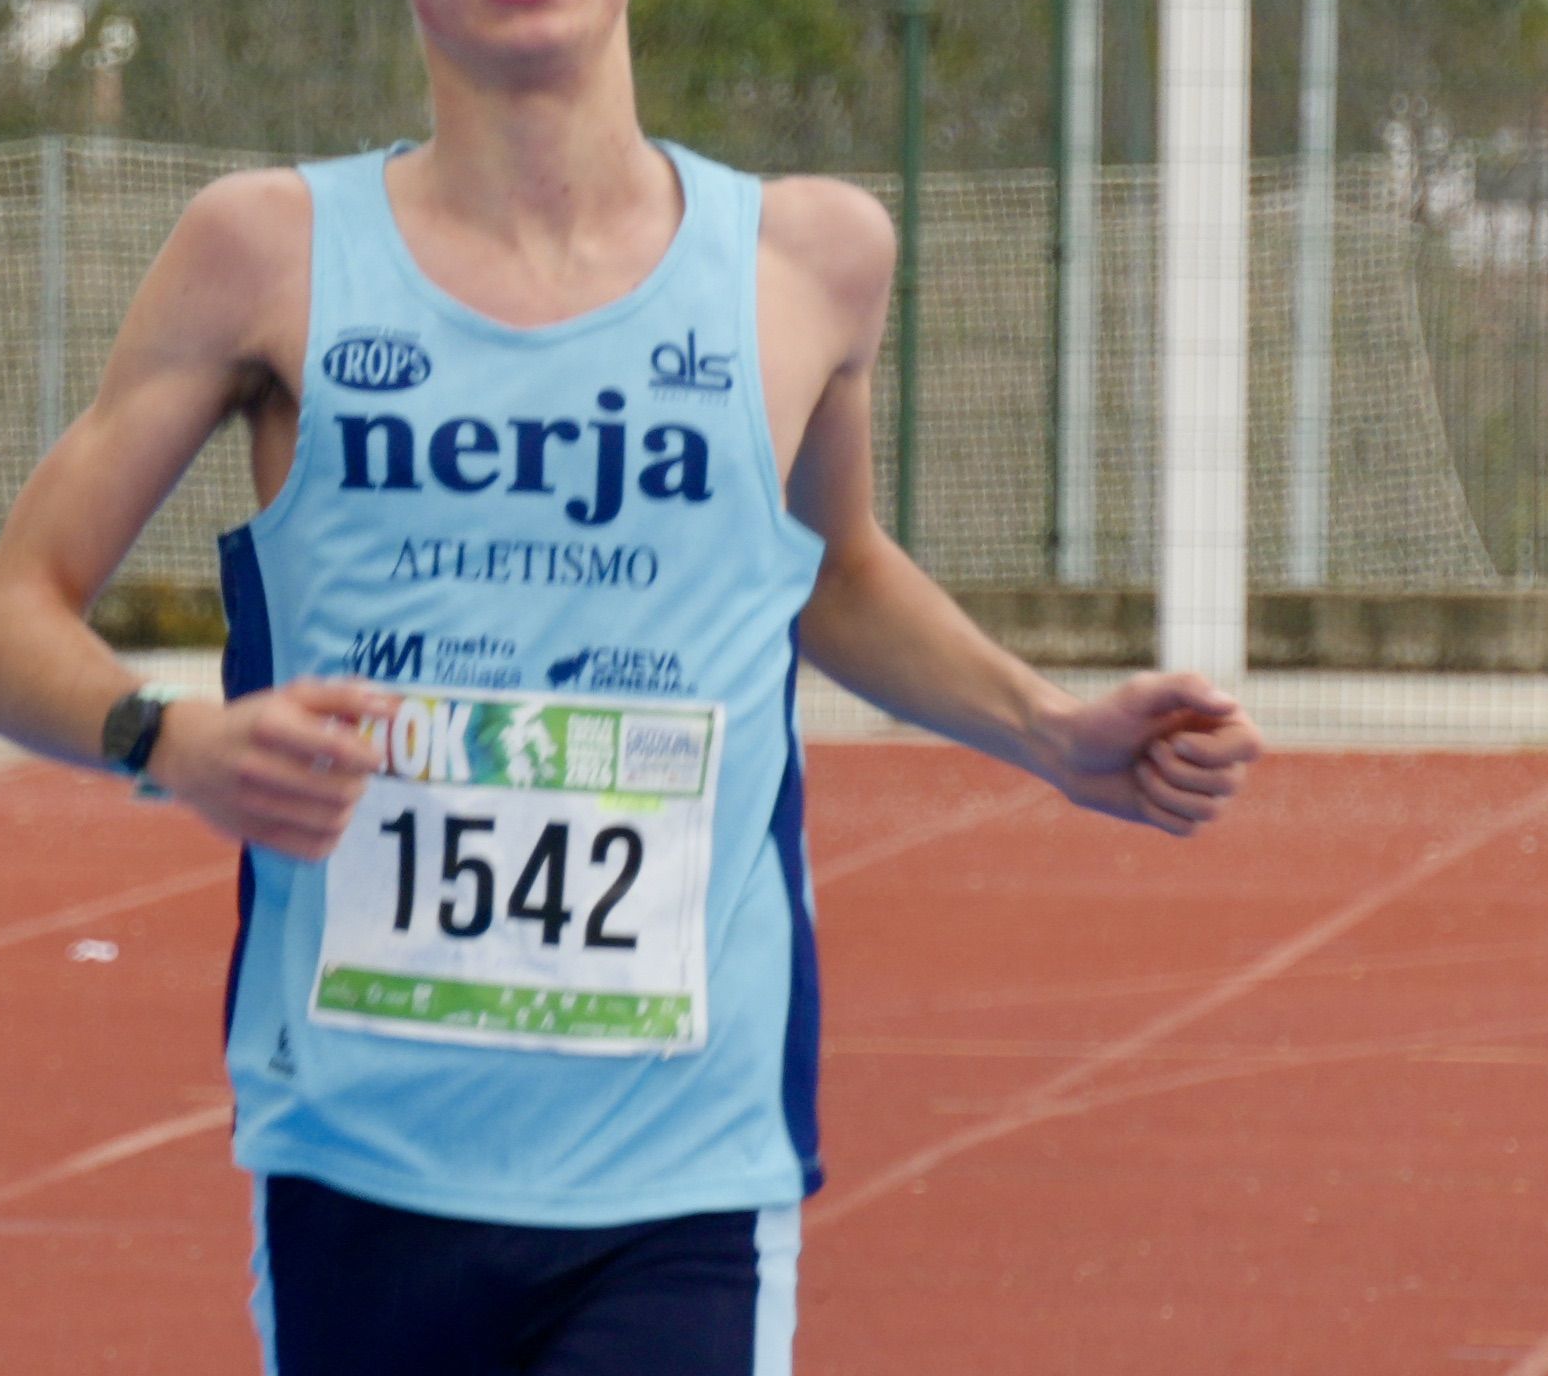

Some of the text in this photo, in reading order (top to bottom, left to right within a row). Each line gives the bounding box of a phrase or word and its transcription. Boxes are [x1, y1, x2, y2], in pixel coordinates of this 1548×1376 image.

[326, 338, 429, 388] TROPS
[334, 387, 714, 528] nerja
[390, 535, 660, 589] ATLETISMO
[435, 632, 517, 661] metro
[379, 810, 646, 951] 1542
